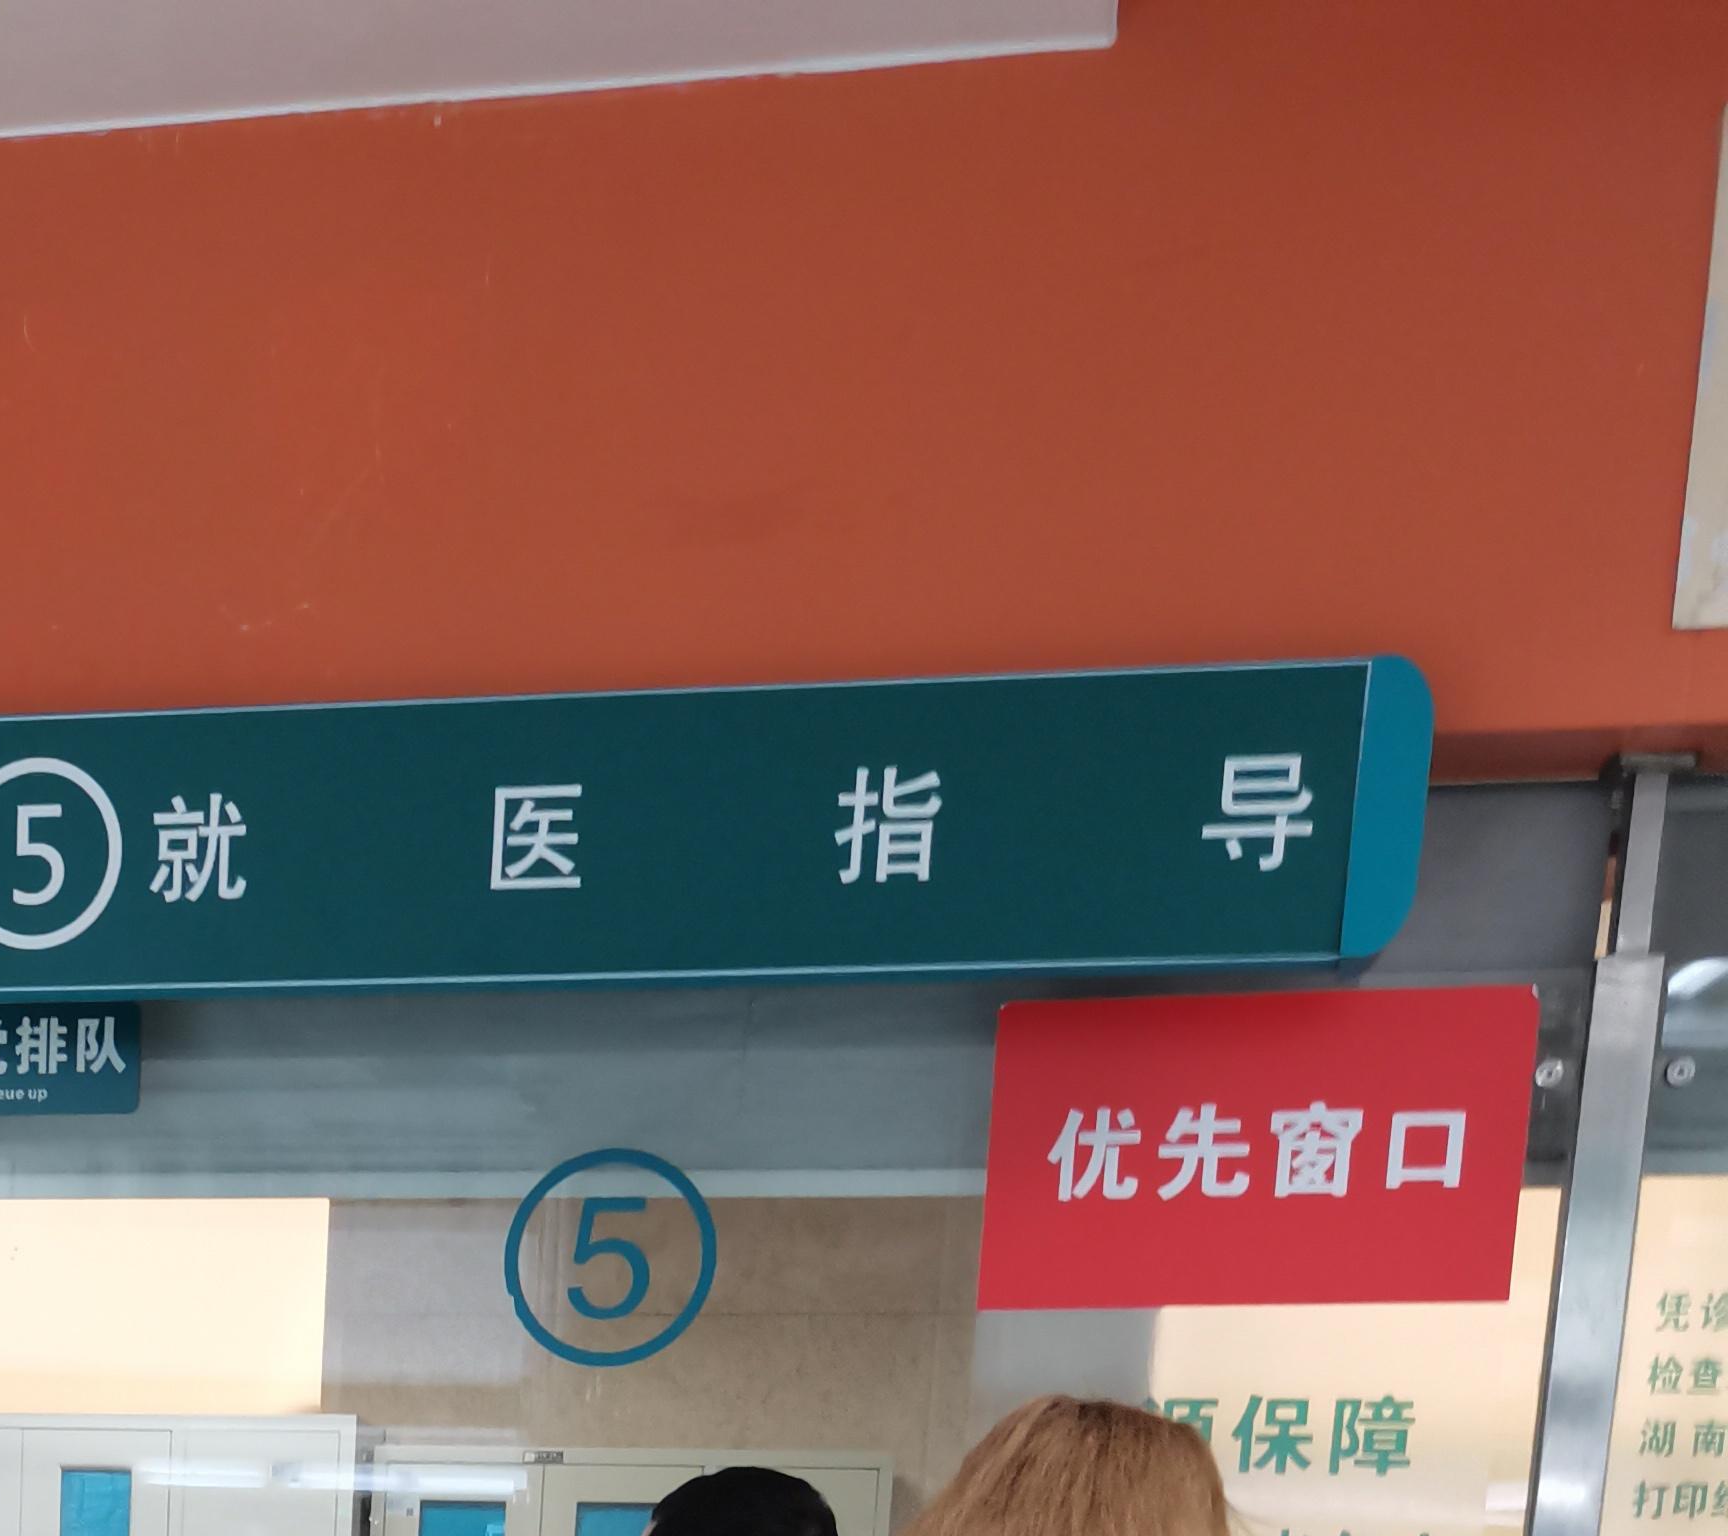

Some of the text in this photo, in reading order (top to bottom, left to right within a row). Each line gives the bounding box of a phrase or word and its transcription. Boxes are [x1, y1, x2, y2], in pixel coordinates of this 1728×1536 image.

[28, 1088, 48, 1102] up
[1047, 1101, 1468, 1203] 优先窗口
